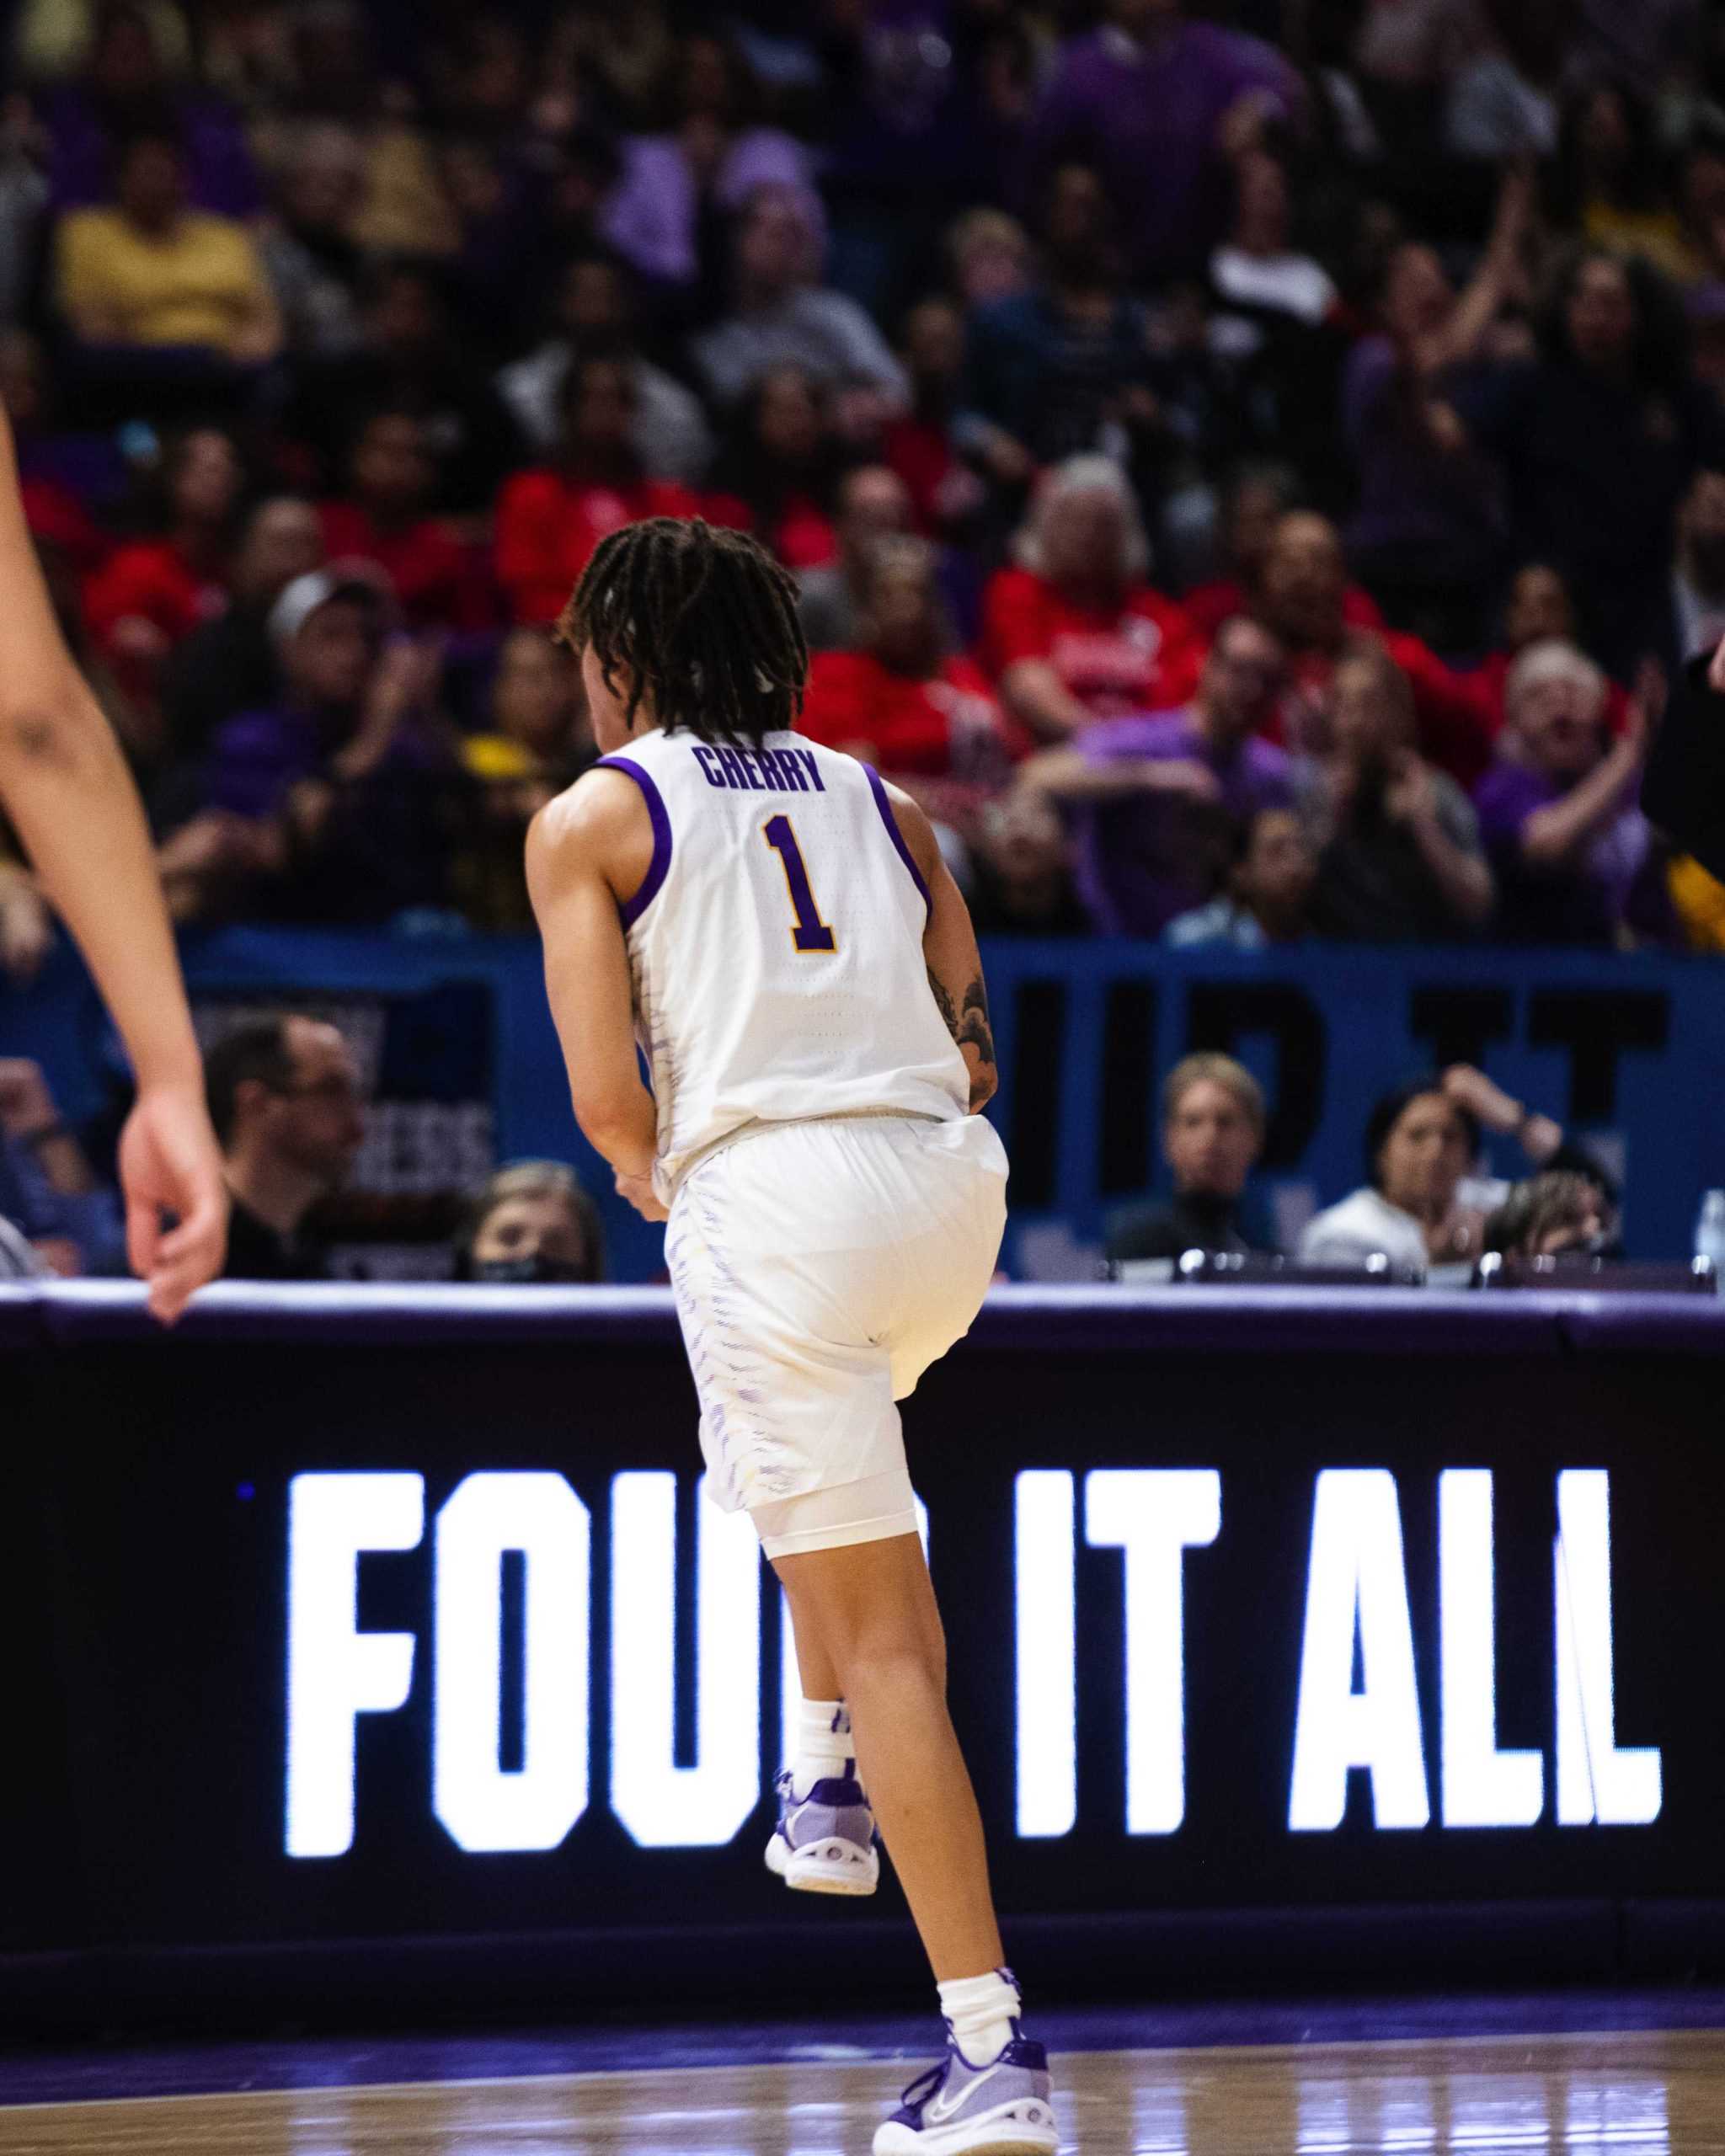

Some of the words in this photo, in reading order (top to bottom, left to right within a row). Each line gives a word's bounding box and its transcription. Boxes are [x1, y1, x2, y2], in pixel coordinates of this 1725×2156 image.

[691, 746, 826, 792] CHERRY
[762, 813, 838, 953] 1
[285, 1470, 929, 1858] FOU
[1014, 1468, 1222, 1838] IT
[1287, 1467, 1663, 1831] ALL
